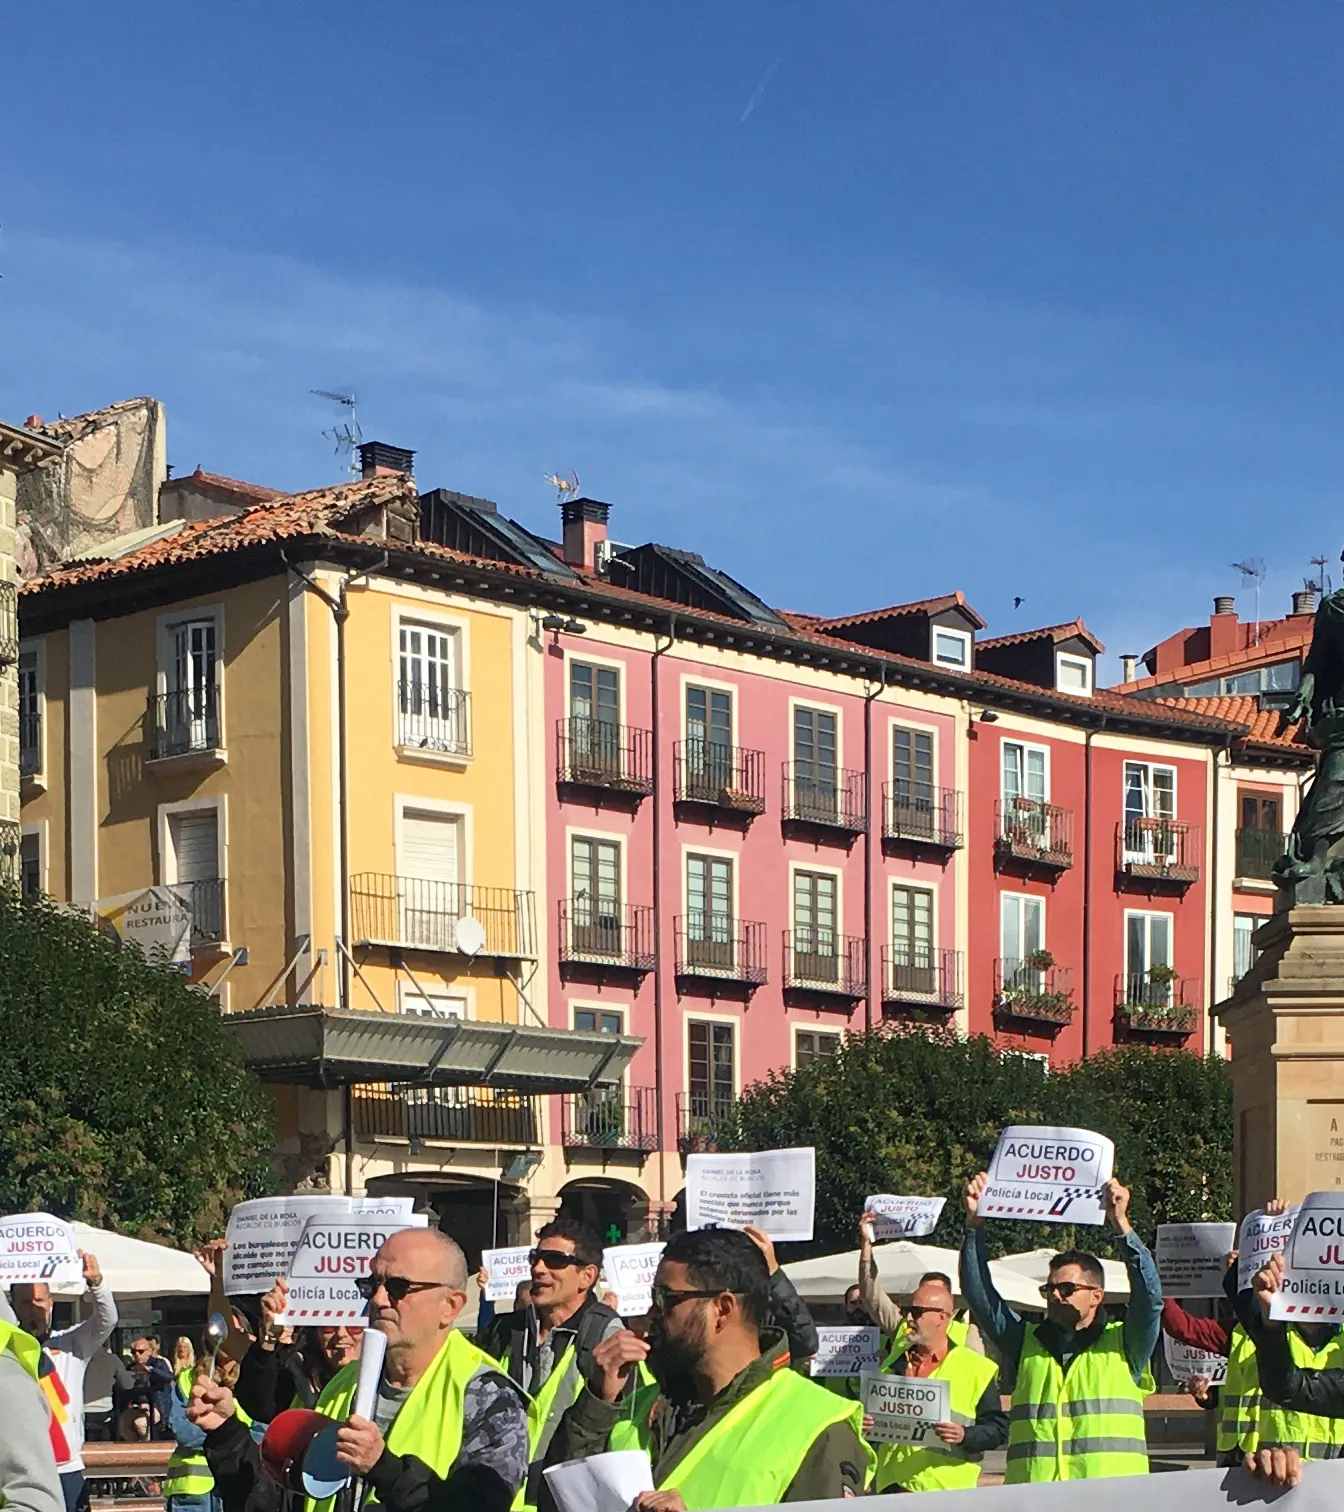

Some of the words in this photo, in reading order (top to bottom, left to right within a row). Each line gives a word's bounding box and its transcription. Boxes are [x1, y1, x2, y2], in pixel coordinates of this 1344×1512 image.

[1329, 1118, 1338, 1132] A
[1005, 1143, 1095, 1162] ACUERDO
[1016, 1164, 1076, 1182] JUSTO
[709, 1191, 738, 1199] cronista
[740, 1191, 762, 1199] oficial
[763, 1190, 781, 1198] tiene
[783, 1189, 800, 1197] más
[985, 1186, 1021, 1199] Policía
[1024, 1188, 1054, 1201] Local
[699, 1198, 725, 1207] sentido
[765, 1200, 791, 1208] porque
[874, 1199, 933, 1207] ACUERDO
[699, 1206, 728, 1215] estamos
[730, 1208, 770, 1216] abrumados
[771, 1208, 784, 1216] por
[786, 1208, 798, 1216] las
[880, 1205, 919, 1213] JUSTO
[279, 1212, 298, 1220] ROSA
[1247, 1218, 1295, 1237] ACUER
[233, 1242, 247, 1250] Los
[248, 1240, 289, 1250] burgaleses
[299, 1232, 387, 1249] ACUERD
[1252, 1234, 1289, 1252] JUST
[7, 1240, 55, 1253] JUSTO
[232, 1251, 258, 1260] alcalde
[259, 1251, 274, 1259] que
[494, 1254, 530, 1265] ACUER
[17, 1260, 41, 1269] Local
[232, 1263, 246, 1271] que
[620, 1256, 658, 1271] ACUE
[503, 1265, 529, 1276] JUST
[1281, 1278, 1330, 1295] Policía
[288, 1286, 325, 1300] olicía
[821, 1334, 870, 1343] ACUERDO
[828, 1344, 861, 1353] JUSTO
[870, 1384, 936, 1402] ACUERDO
[879, 1401, 923, 1416] JUSTO
[889, 1420, 911, 1430] Local
